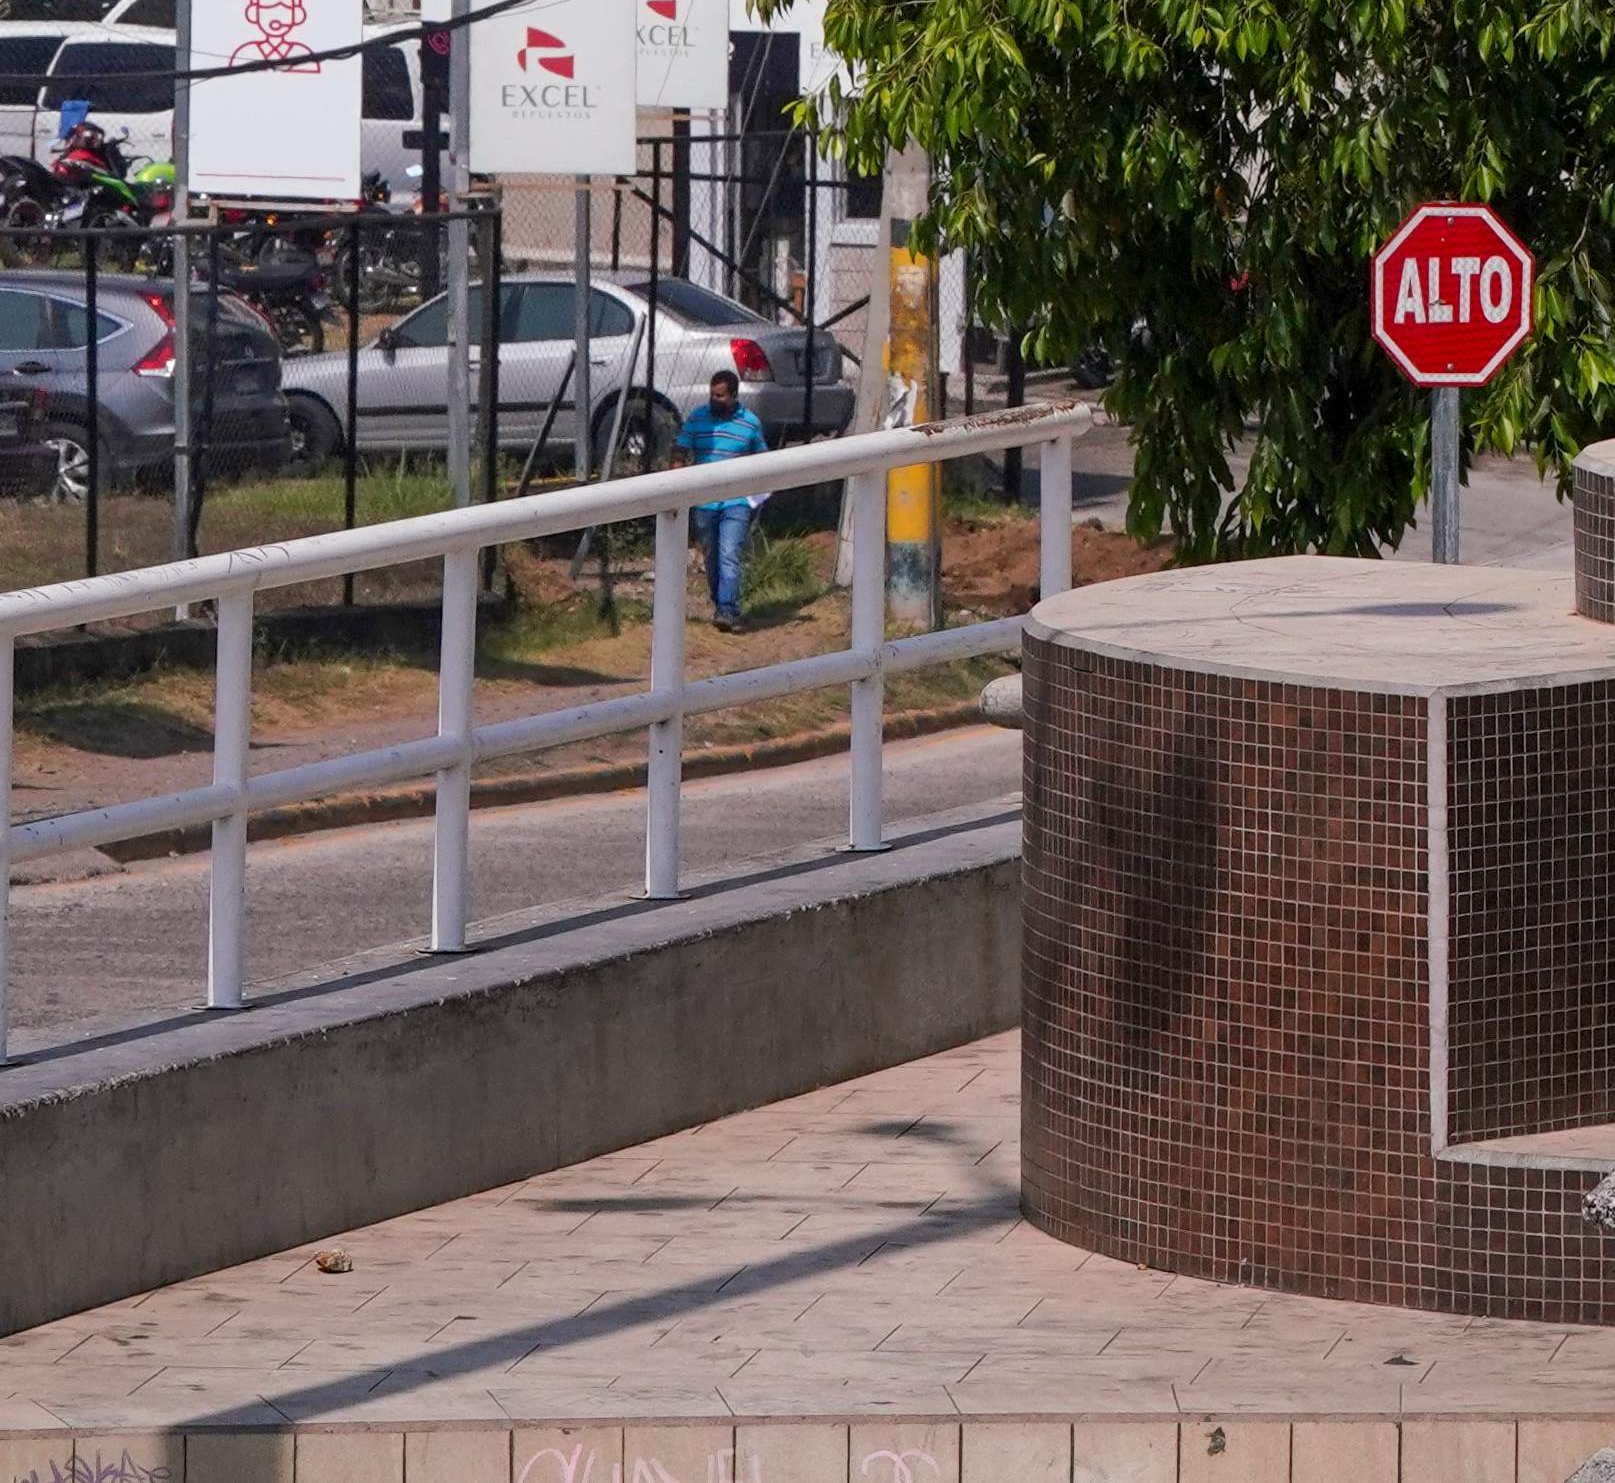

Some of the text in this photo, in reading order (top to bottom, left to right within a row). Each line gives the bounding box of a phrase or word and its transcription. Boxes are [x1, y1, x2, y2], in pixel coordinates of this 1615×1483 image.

[635, 25, 697, 47] XCEL
[501, 84, 599, 109] EXCEL
[1393, 254, 1513, 325] ALTO
